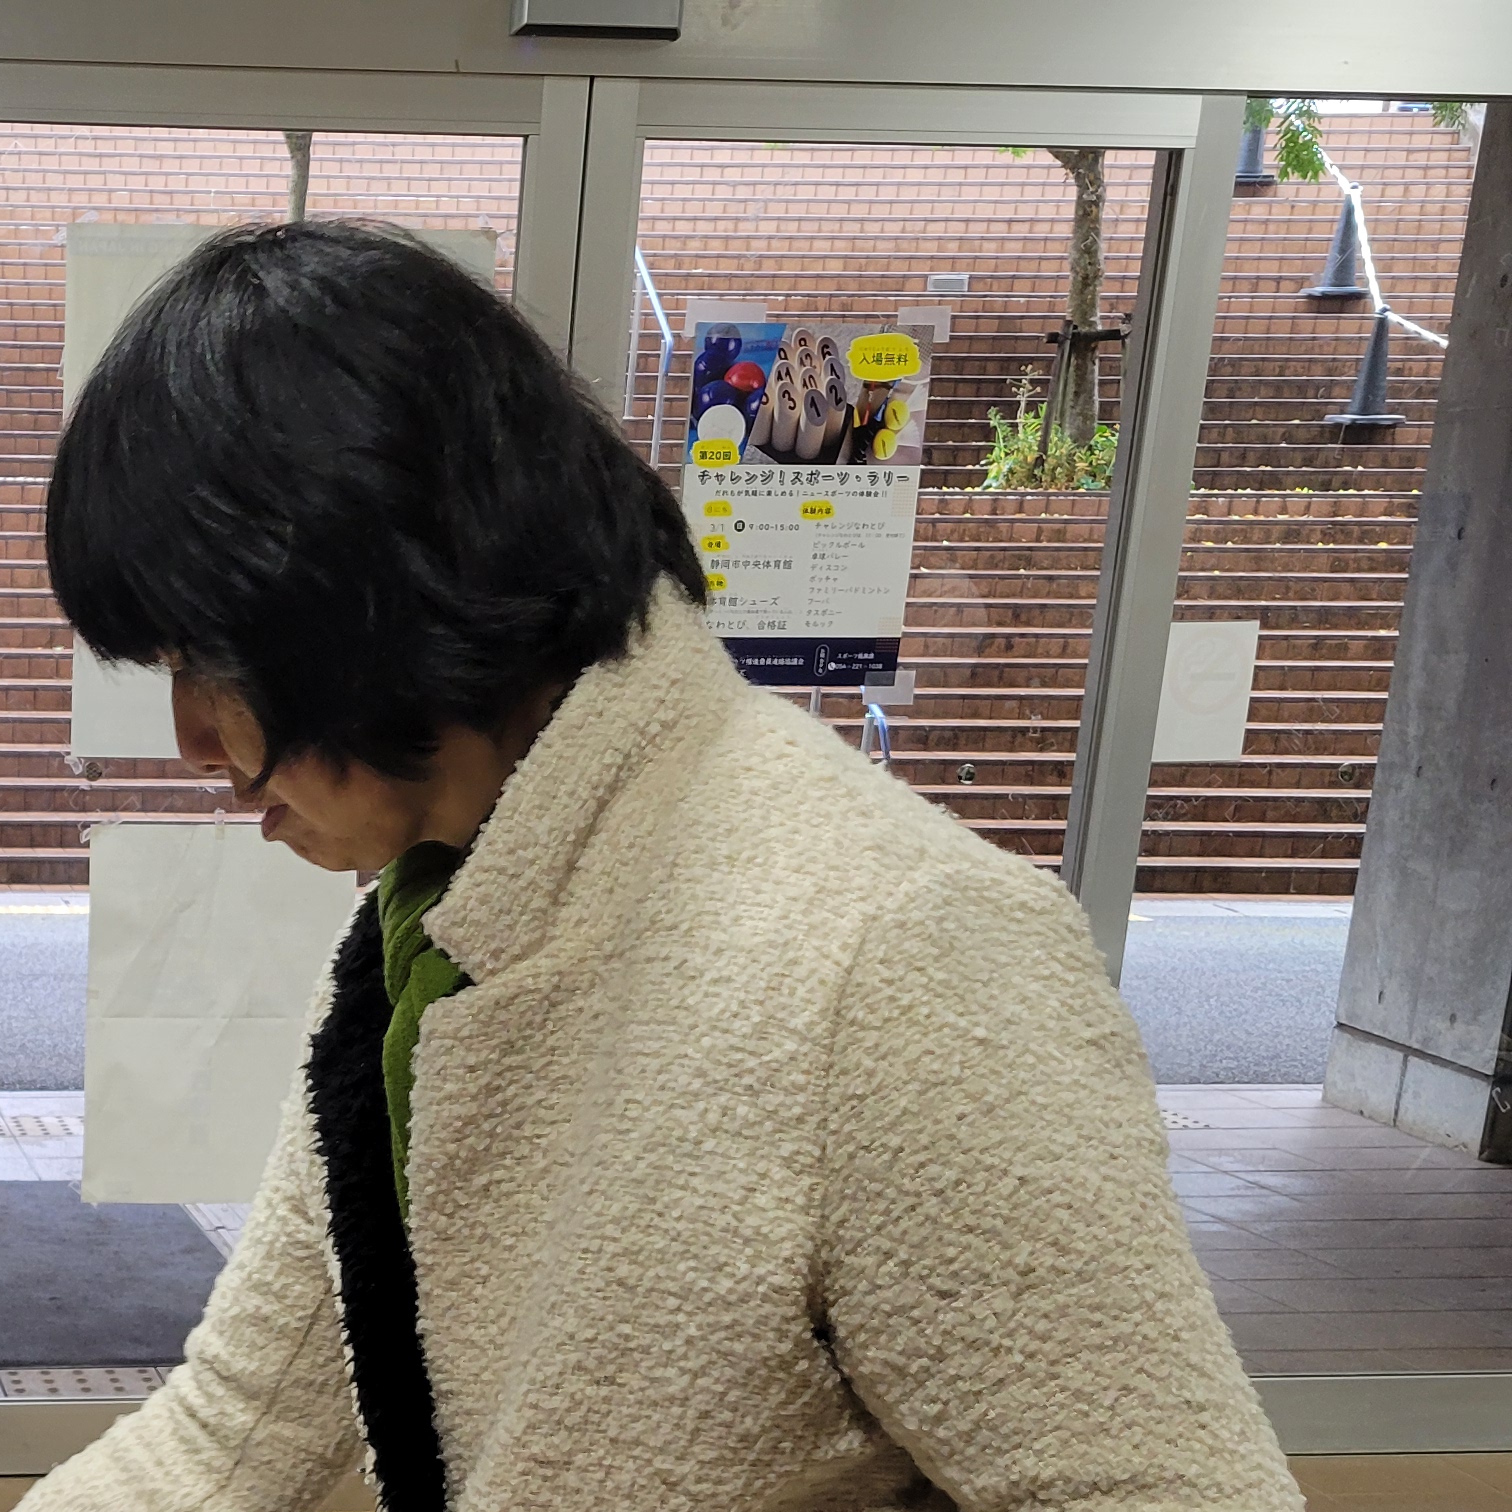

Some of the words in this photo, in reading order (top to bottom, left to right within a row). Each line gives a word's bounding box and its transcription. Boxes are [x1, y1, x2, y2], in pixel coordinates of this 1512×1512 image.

[859, 353, 908, 366] 入場無料
[782, 389, 797, 411] 3
[829, 384, 843, 406] 2
[810, 396, 821, 418] 1
[699, 451, 732, 461] 第20回
[815, 522, 886, 531] チャレンジなわとび
[813, 541, 866, 549] ピックルボール
[710, 559, 793, 570] 静岡市中央体育館
